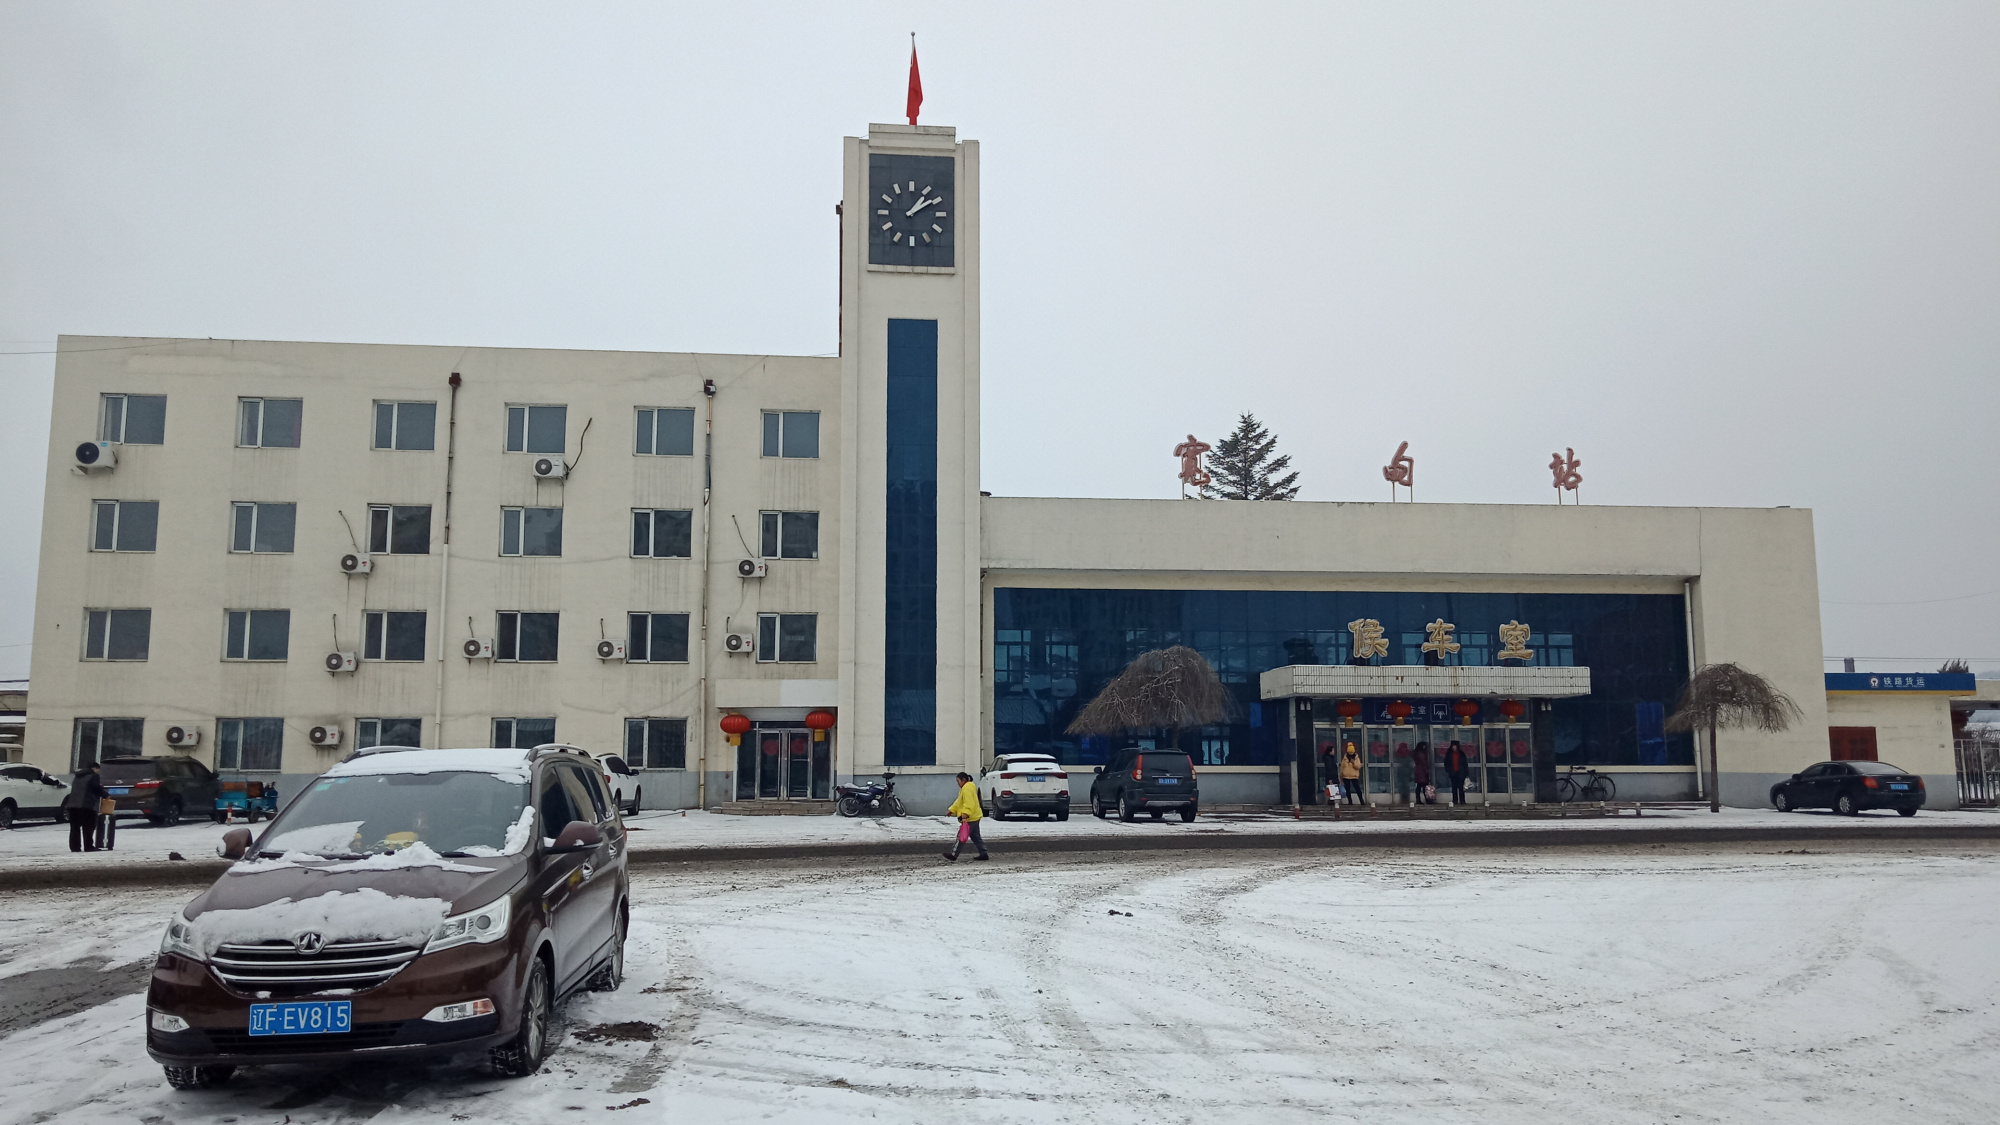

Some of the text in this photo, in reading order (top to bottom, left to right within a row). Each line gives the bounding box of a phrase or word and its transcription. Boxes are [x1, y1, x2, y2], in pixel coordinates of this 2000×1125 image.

[1347, 617, 1534, 660] 候车室
[1884, 677, 1925, 685] 铁路货运
